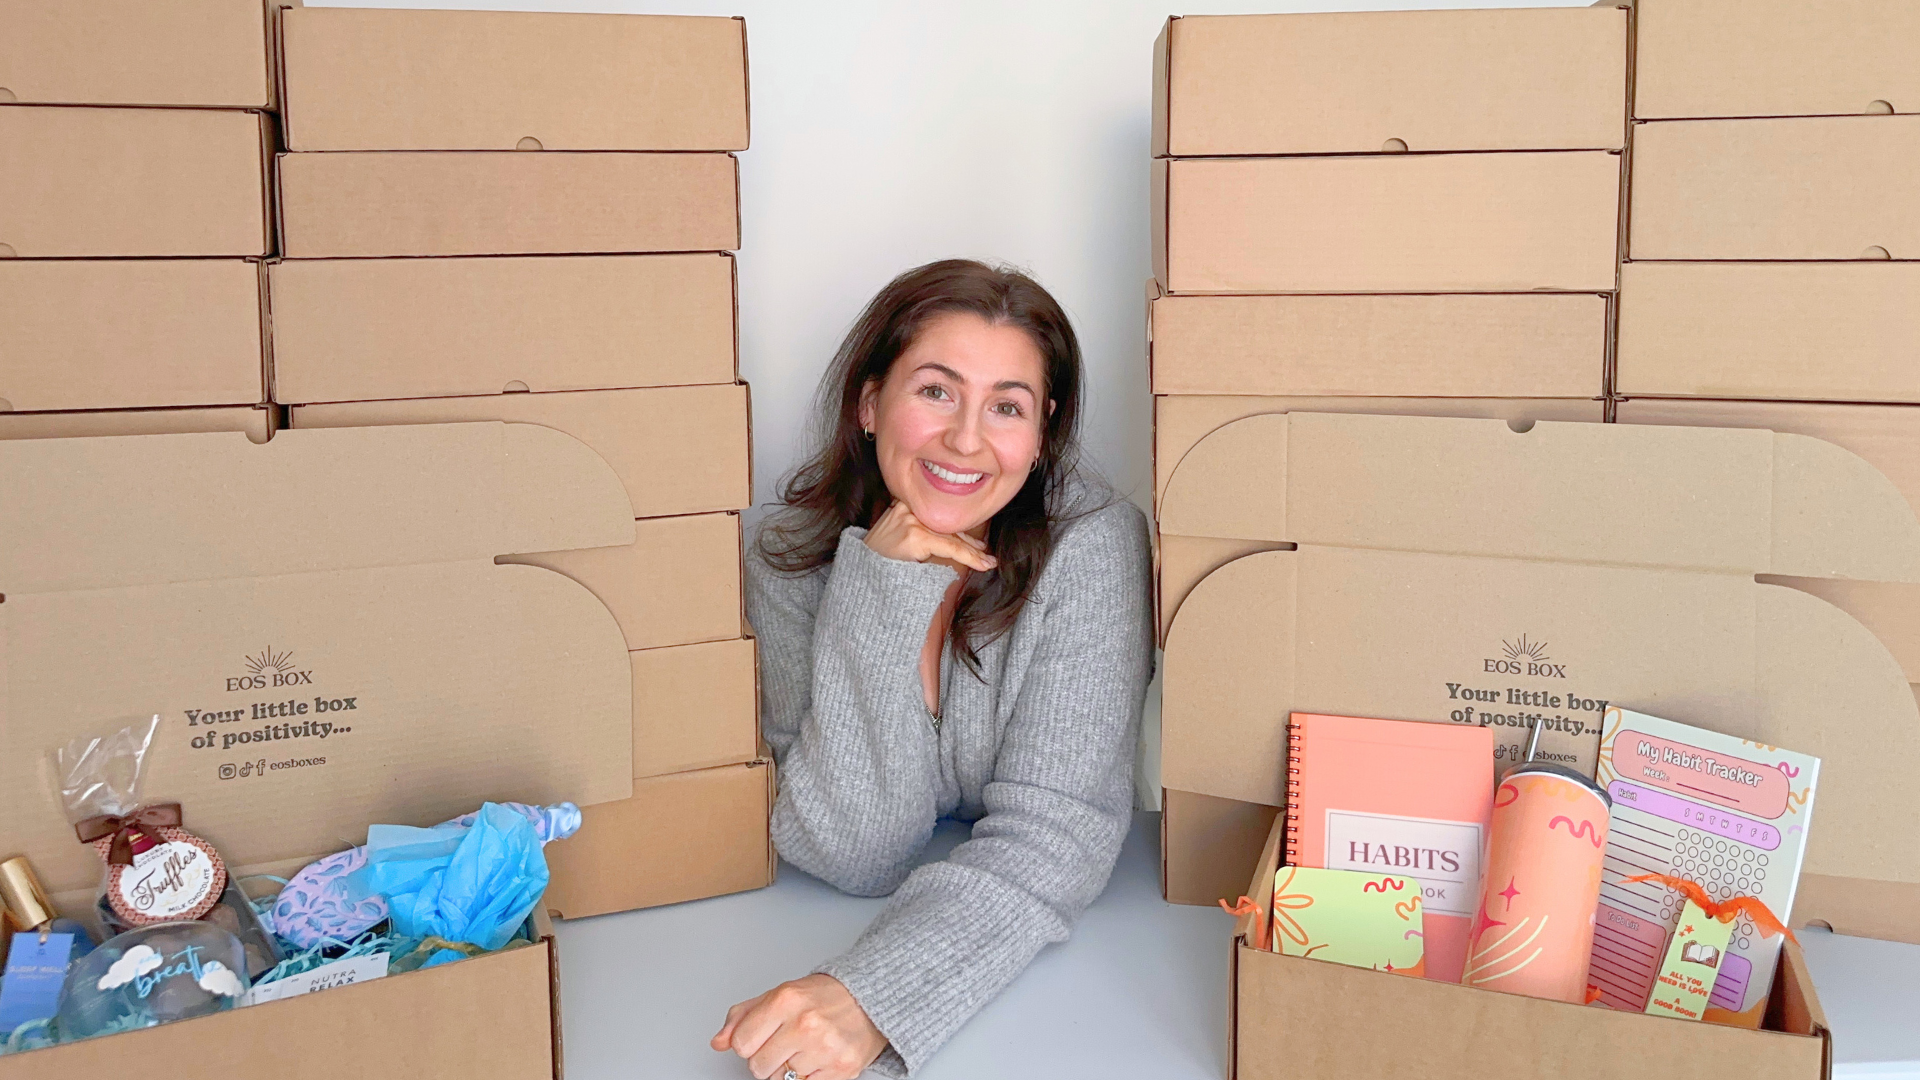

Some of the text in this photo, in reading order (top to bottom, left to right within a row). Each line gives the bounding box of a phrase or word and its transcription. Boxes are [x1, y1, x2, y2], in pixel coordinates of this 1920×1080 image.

[1484, 659, 1566, 678] EOS BOX
[226, 670, 313, 692] EOS BOX
[1446, 683, 1609, 712] Your little box
[185, 697, 357, 726] Your little box
[1451, 707, 1474, 723] of
[191, 721, 351, 749] of positivity...
[270, 756, 326, 770] eosboxes
[1523, 750, 1577, 763] sboxes
[1637, 740, 1763, 787] My Habit Tracker
[1618, 788, 1769, 841] Habit S M T W T F S
[1349, 841, 1459, 873] HABITS
[131, 849, 197, 910] Truffles
[168, 868, 210, 912] MILK CHOCOLATE
[1420, 887, 1446, 899] OK
[309, 976, 354, 993] RELAX
[311, 969, 356, 985] NUTRA
[1658, 975, 1677, 986] NEED
[1688, 986, 1708, 997] LOVE
[1669, 971, 1702, 986] ALL YOU
[1653, 998, 1673, 1010] GOOD
